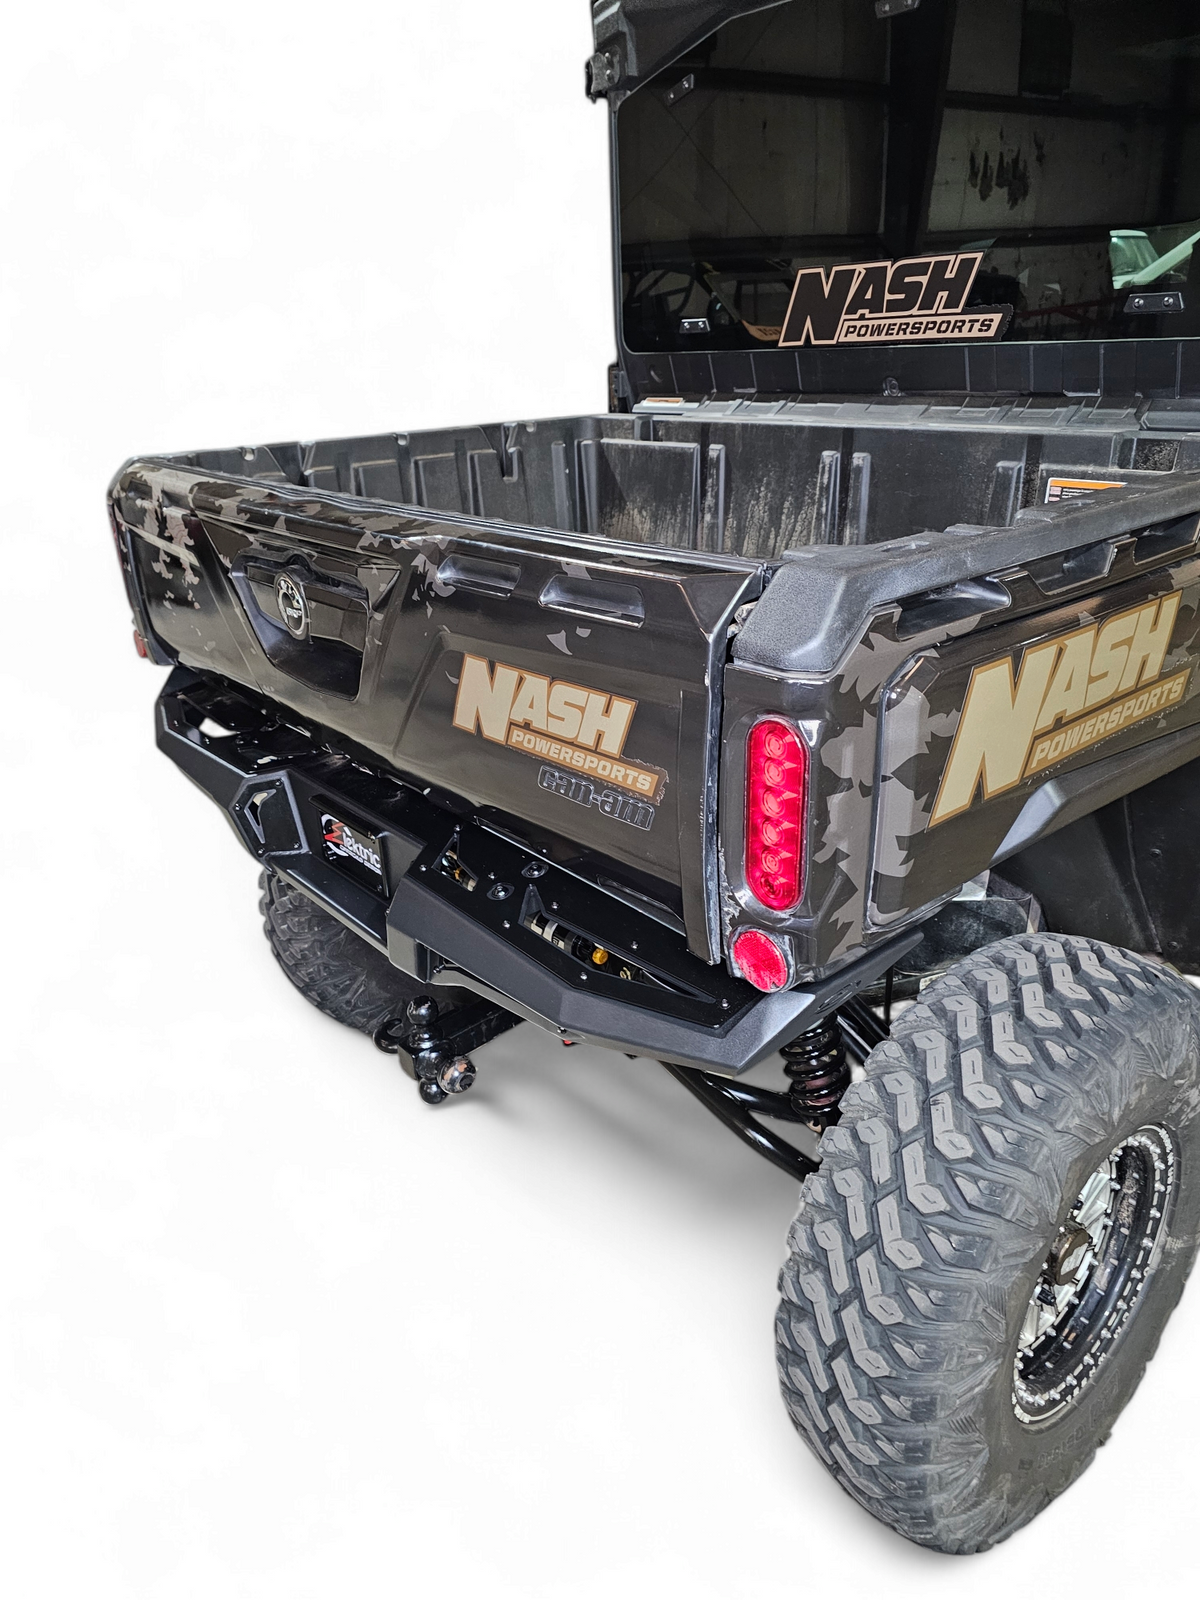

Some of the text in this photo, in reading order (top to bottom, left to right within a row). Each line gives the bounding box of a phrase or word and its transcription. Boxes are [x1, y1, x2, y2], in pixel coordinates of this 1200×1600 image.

[779, 252, 983, 346] NASH
[843, 317, 995, 339] POWERSPORTS
[453, 654, 637, 757] NASH
[928, 591, 1182, 827] NASH
[1030, 676, 1184, 769] POWERSPORTS
[511, 729, 652, 791] POWERSPORTS
